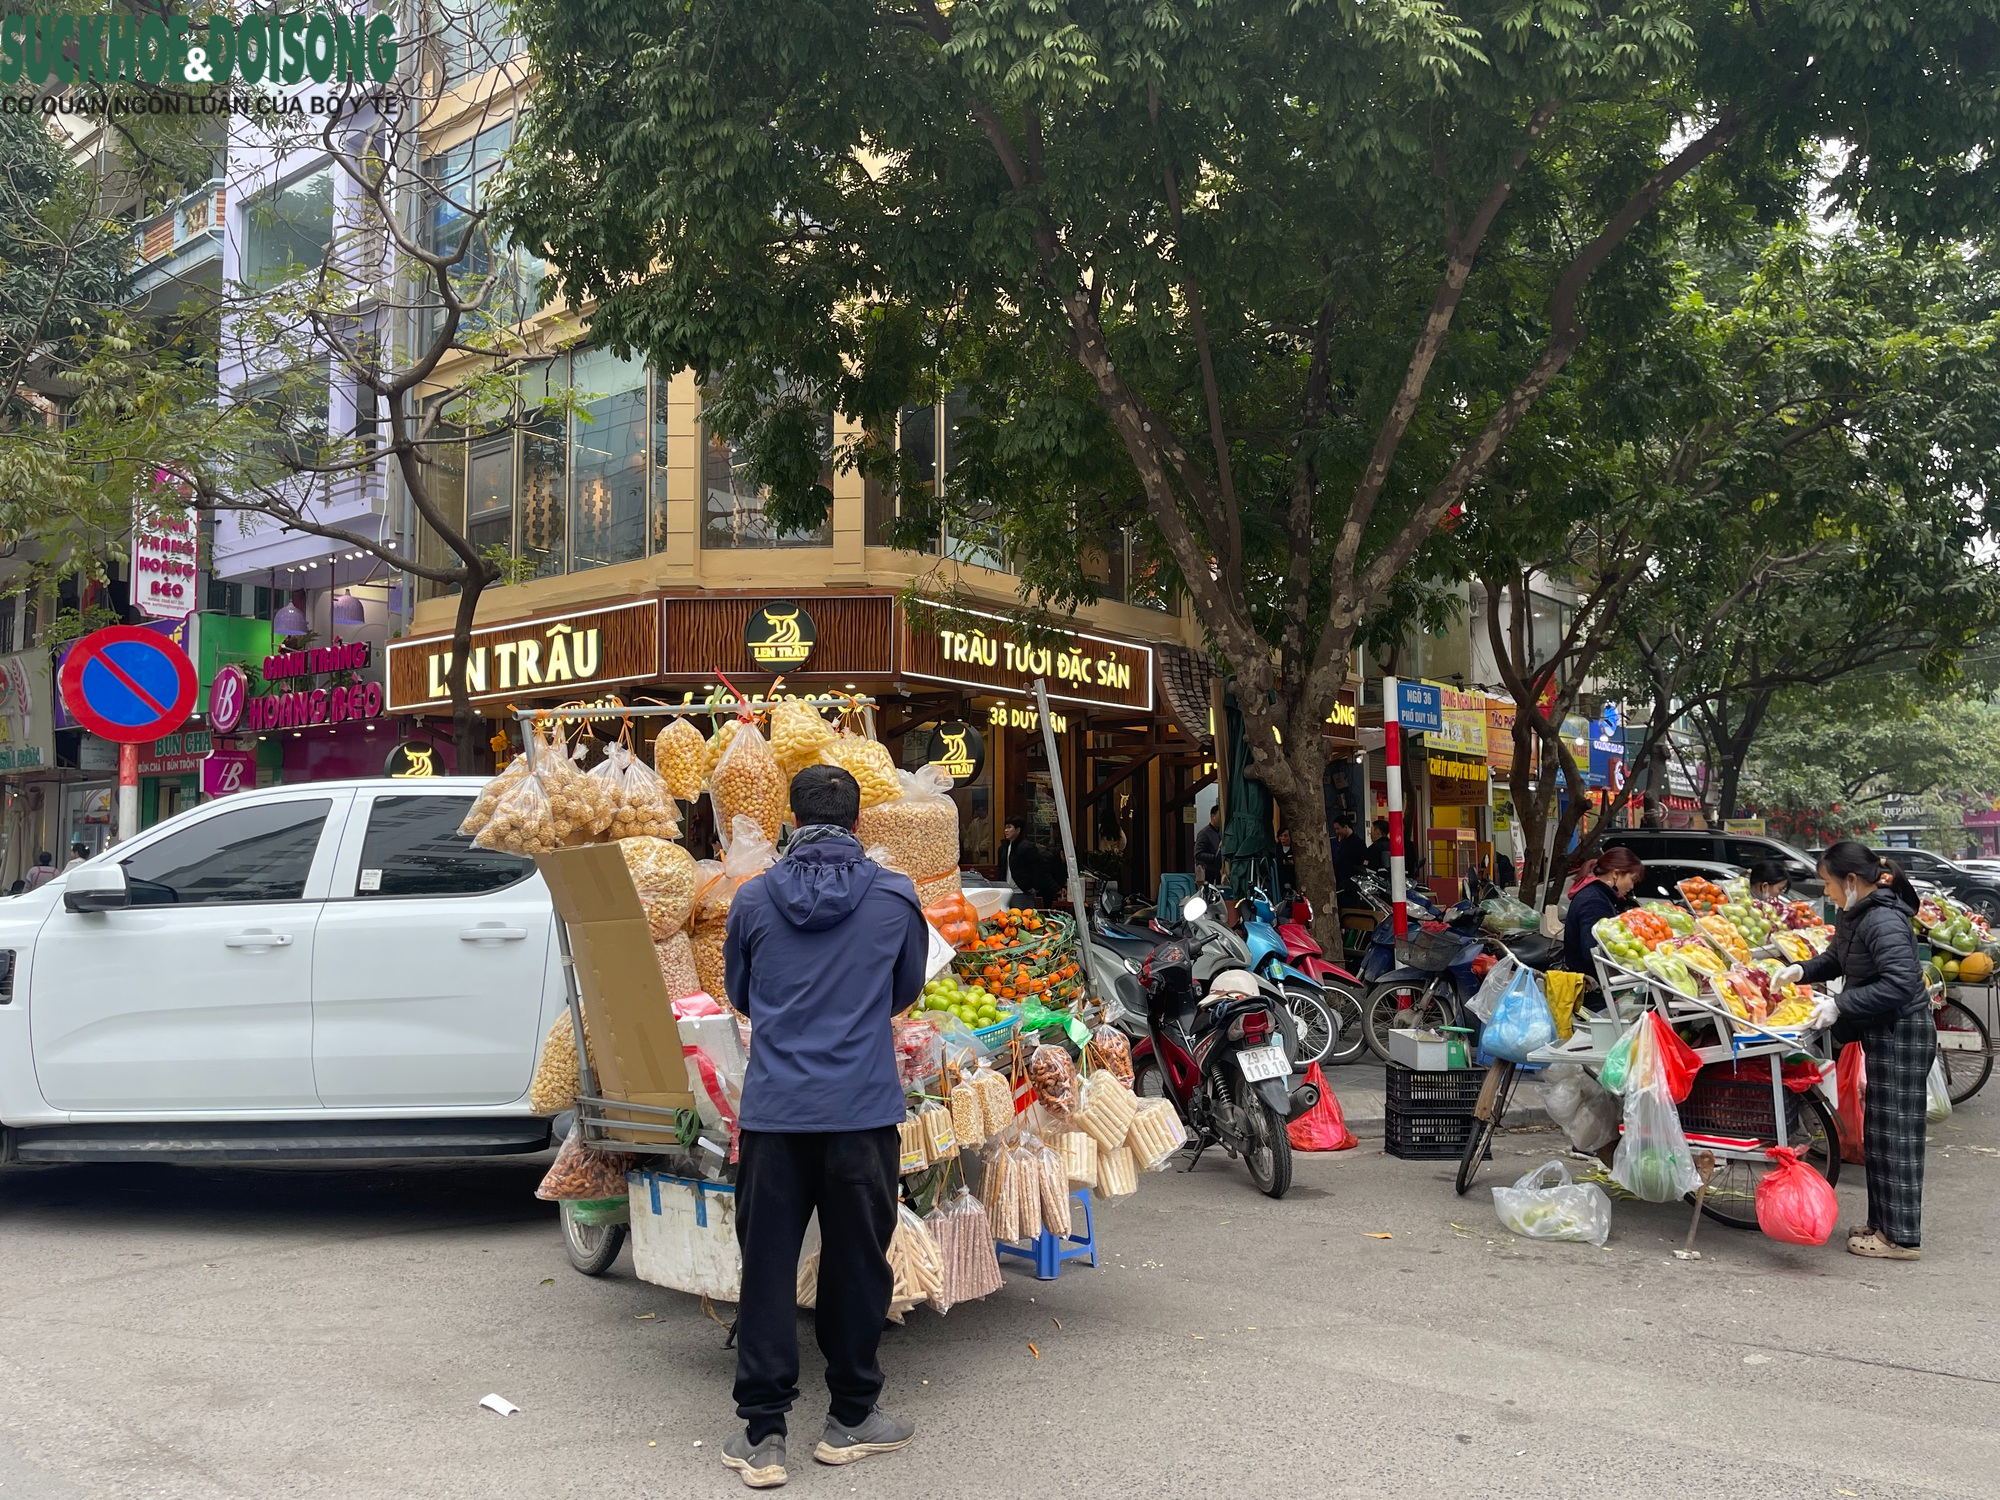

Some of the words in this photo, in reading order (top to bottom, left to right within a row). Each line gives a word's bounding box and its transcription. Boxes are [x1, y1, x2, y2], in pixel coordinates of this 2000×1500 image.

[494, 623, 599, 688] TRÂU
[754, 647, 776, 658] LEN
[777, 644, 809, 658] TRÂU
[1057, 646, 1092, 689] ĐẶC
[1097, 651, 1130, 690] SẢN
[250, 681, 327, 731] HOÀNG
[331, 671, 382, 723] BÈO
[1423, 692, 1432, 706] 36
[989, 706, 1008, 727] 38
[1011, 708, 1038, 730] DUY
[1049, 711, 1067, 733] ÂN
[1401, 708, 1414, 722] PHỐ
[1415, 711, 1426, 724] DUY
[1427, 711, 1438, 726] TÂN
[1245, 1048, 1279, 1065] 29-T2
[1247, 1060, 1288, 1079] 118.18
